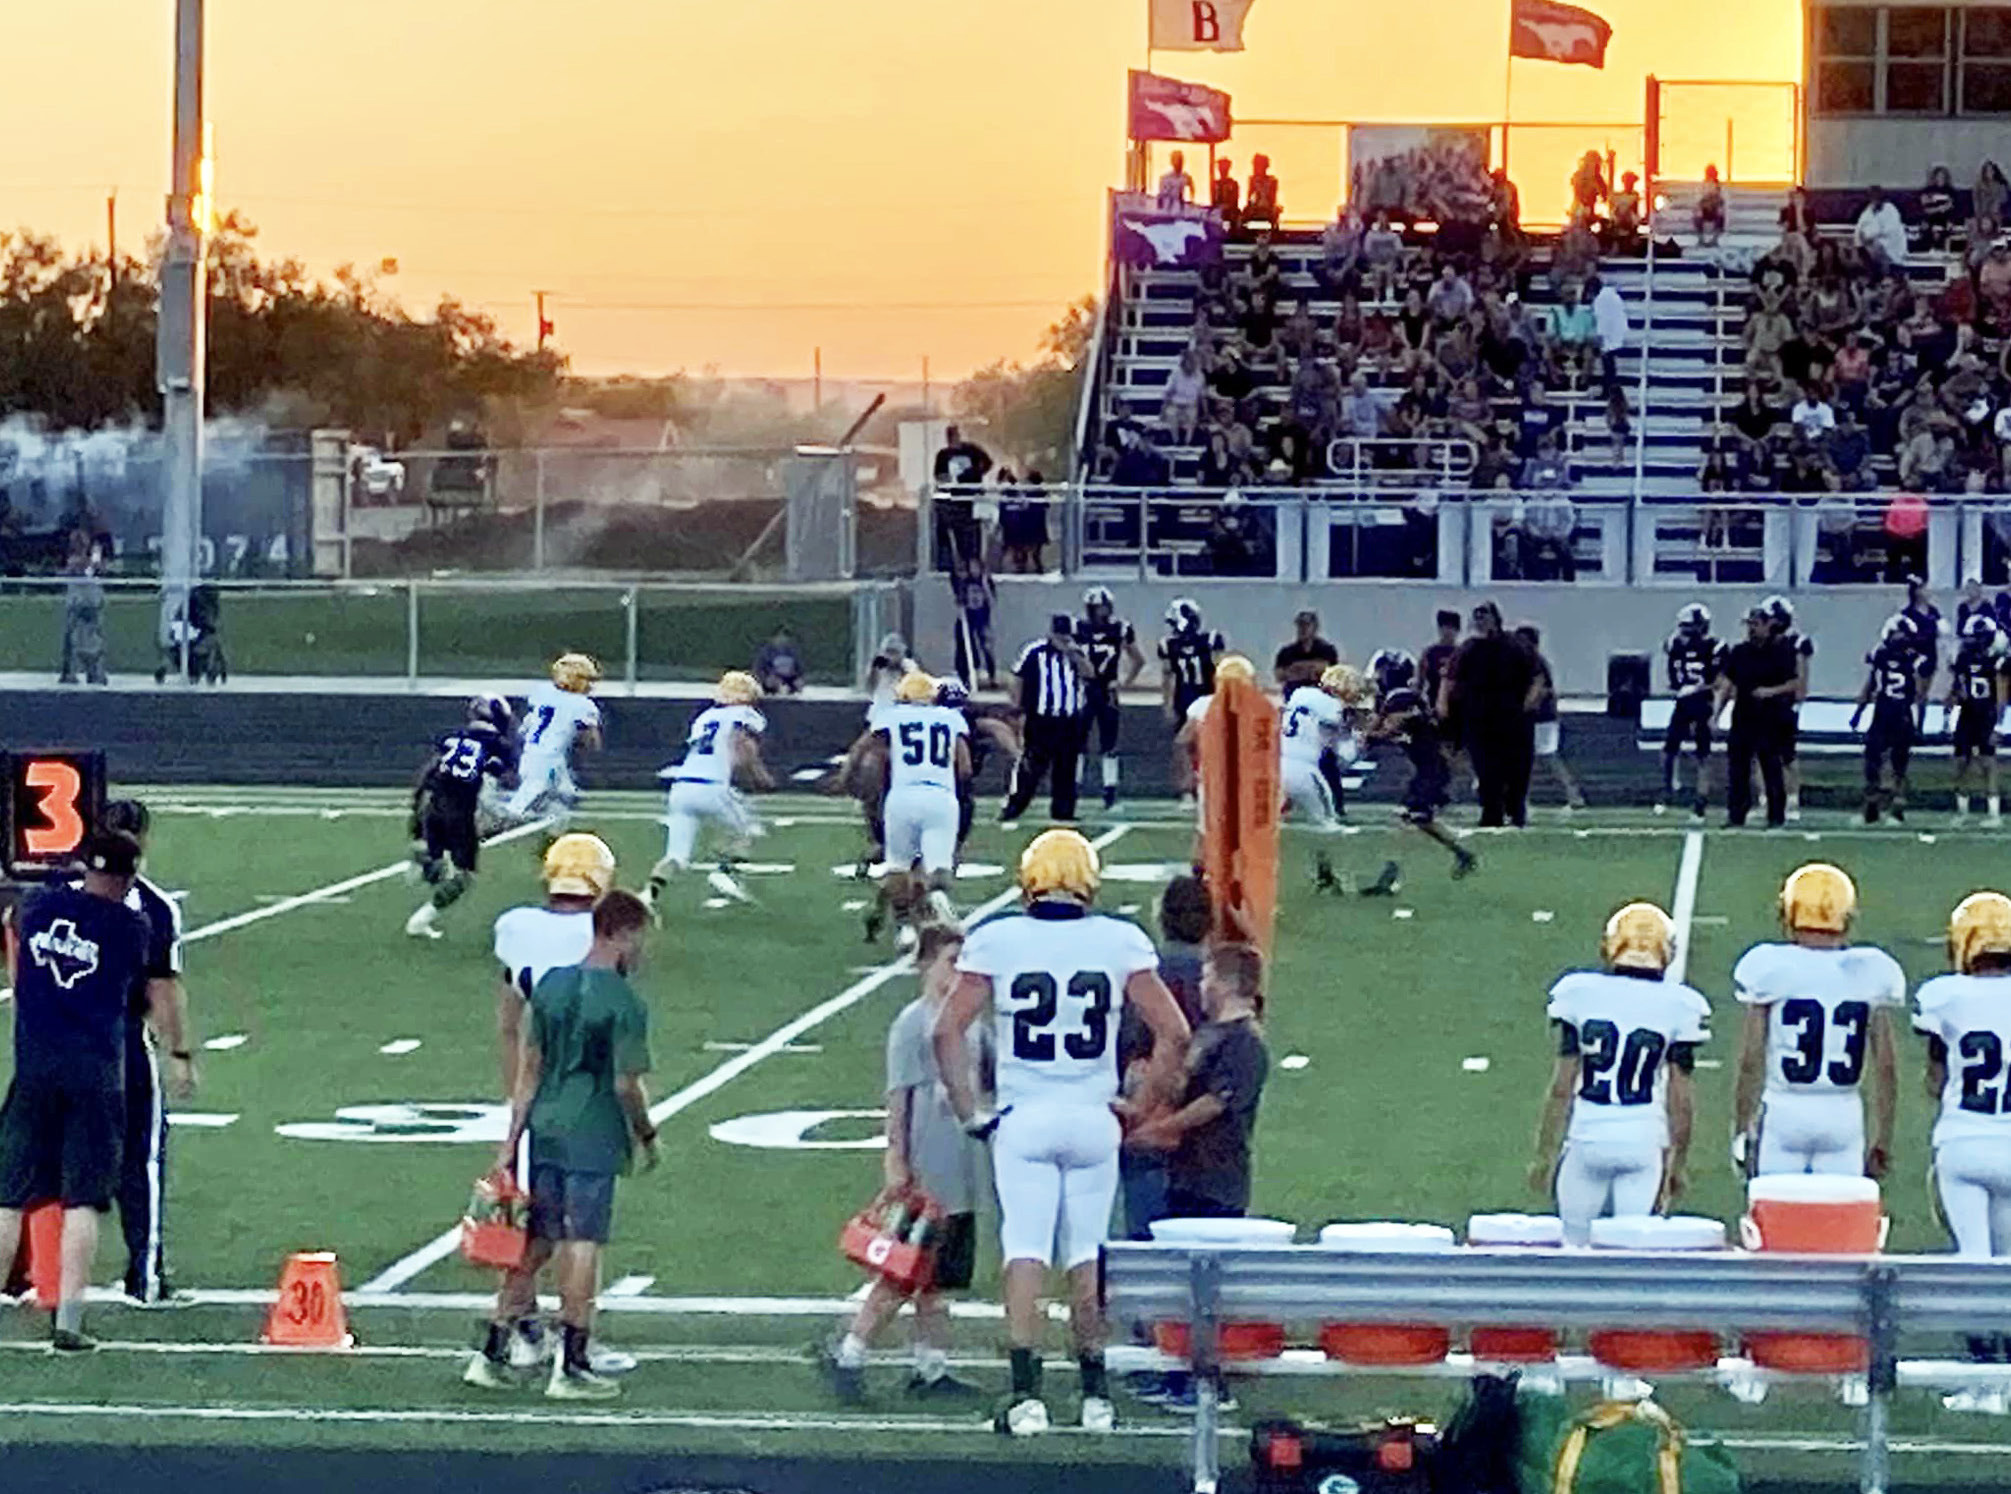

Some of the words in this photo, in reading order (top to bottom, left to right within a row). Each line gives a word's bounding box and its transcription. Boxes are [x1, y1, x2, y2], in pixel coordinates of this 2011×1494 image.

[1192, 1, 1220, 42] B
[1178, 656, 1202, 685] 11
[899, 722, 951, 768] 50
[24, 761, 84, 853] 3
[1010, 970, 1112, 1061] 23
[1782, 999, 1870, 1086] 33
[1578, 1018, 1668, 1106] 20
[286, 1280, 326, 1325] 30
